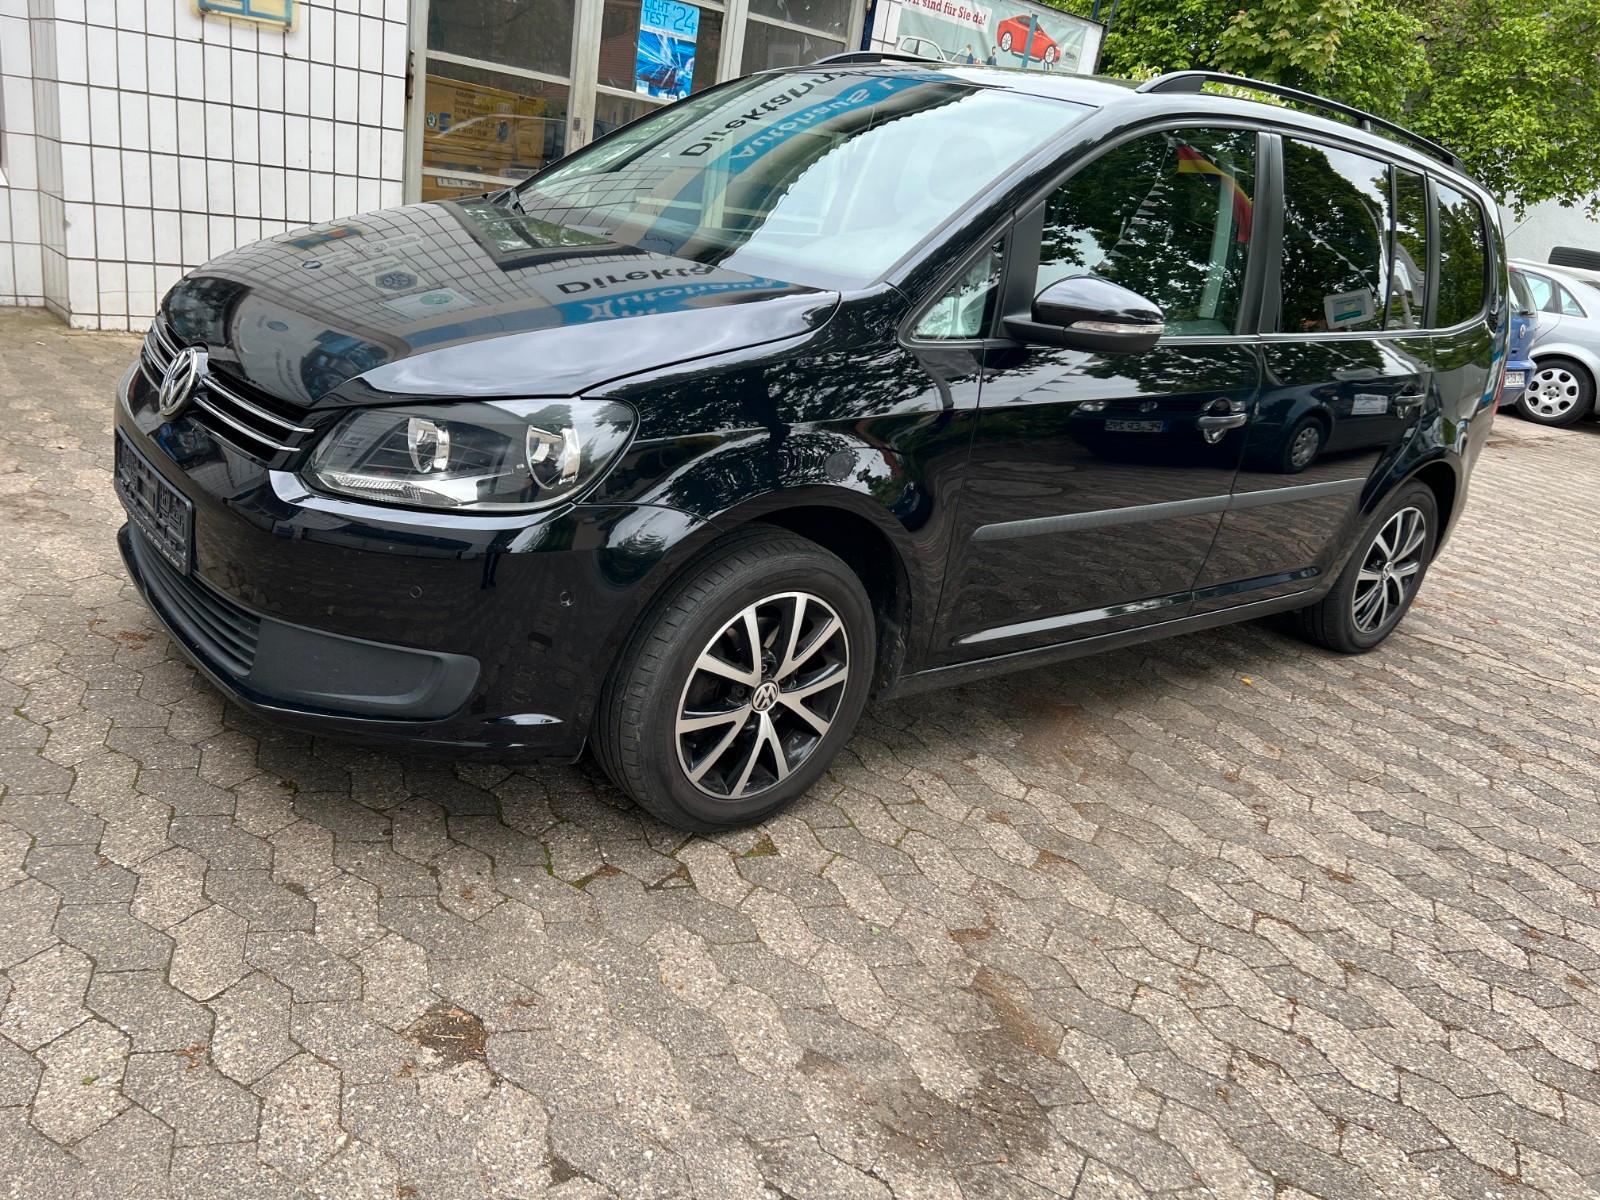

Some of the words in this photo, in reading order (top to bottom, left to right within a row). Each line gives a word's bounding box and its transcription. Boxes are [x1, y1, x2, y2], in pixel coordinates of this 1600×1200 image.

[644, 9, 669, 26] TEST
[922, 0, 942, 12] sind
[943, 2, 957, 17] für
[957, 6, 971, 20] Sie
[972, 12, 987, 25] da!
